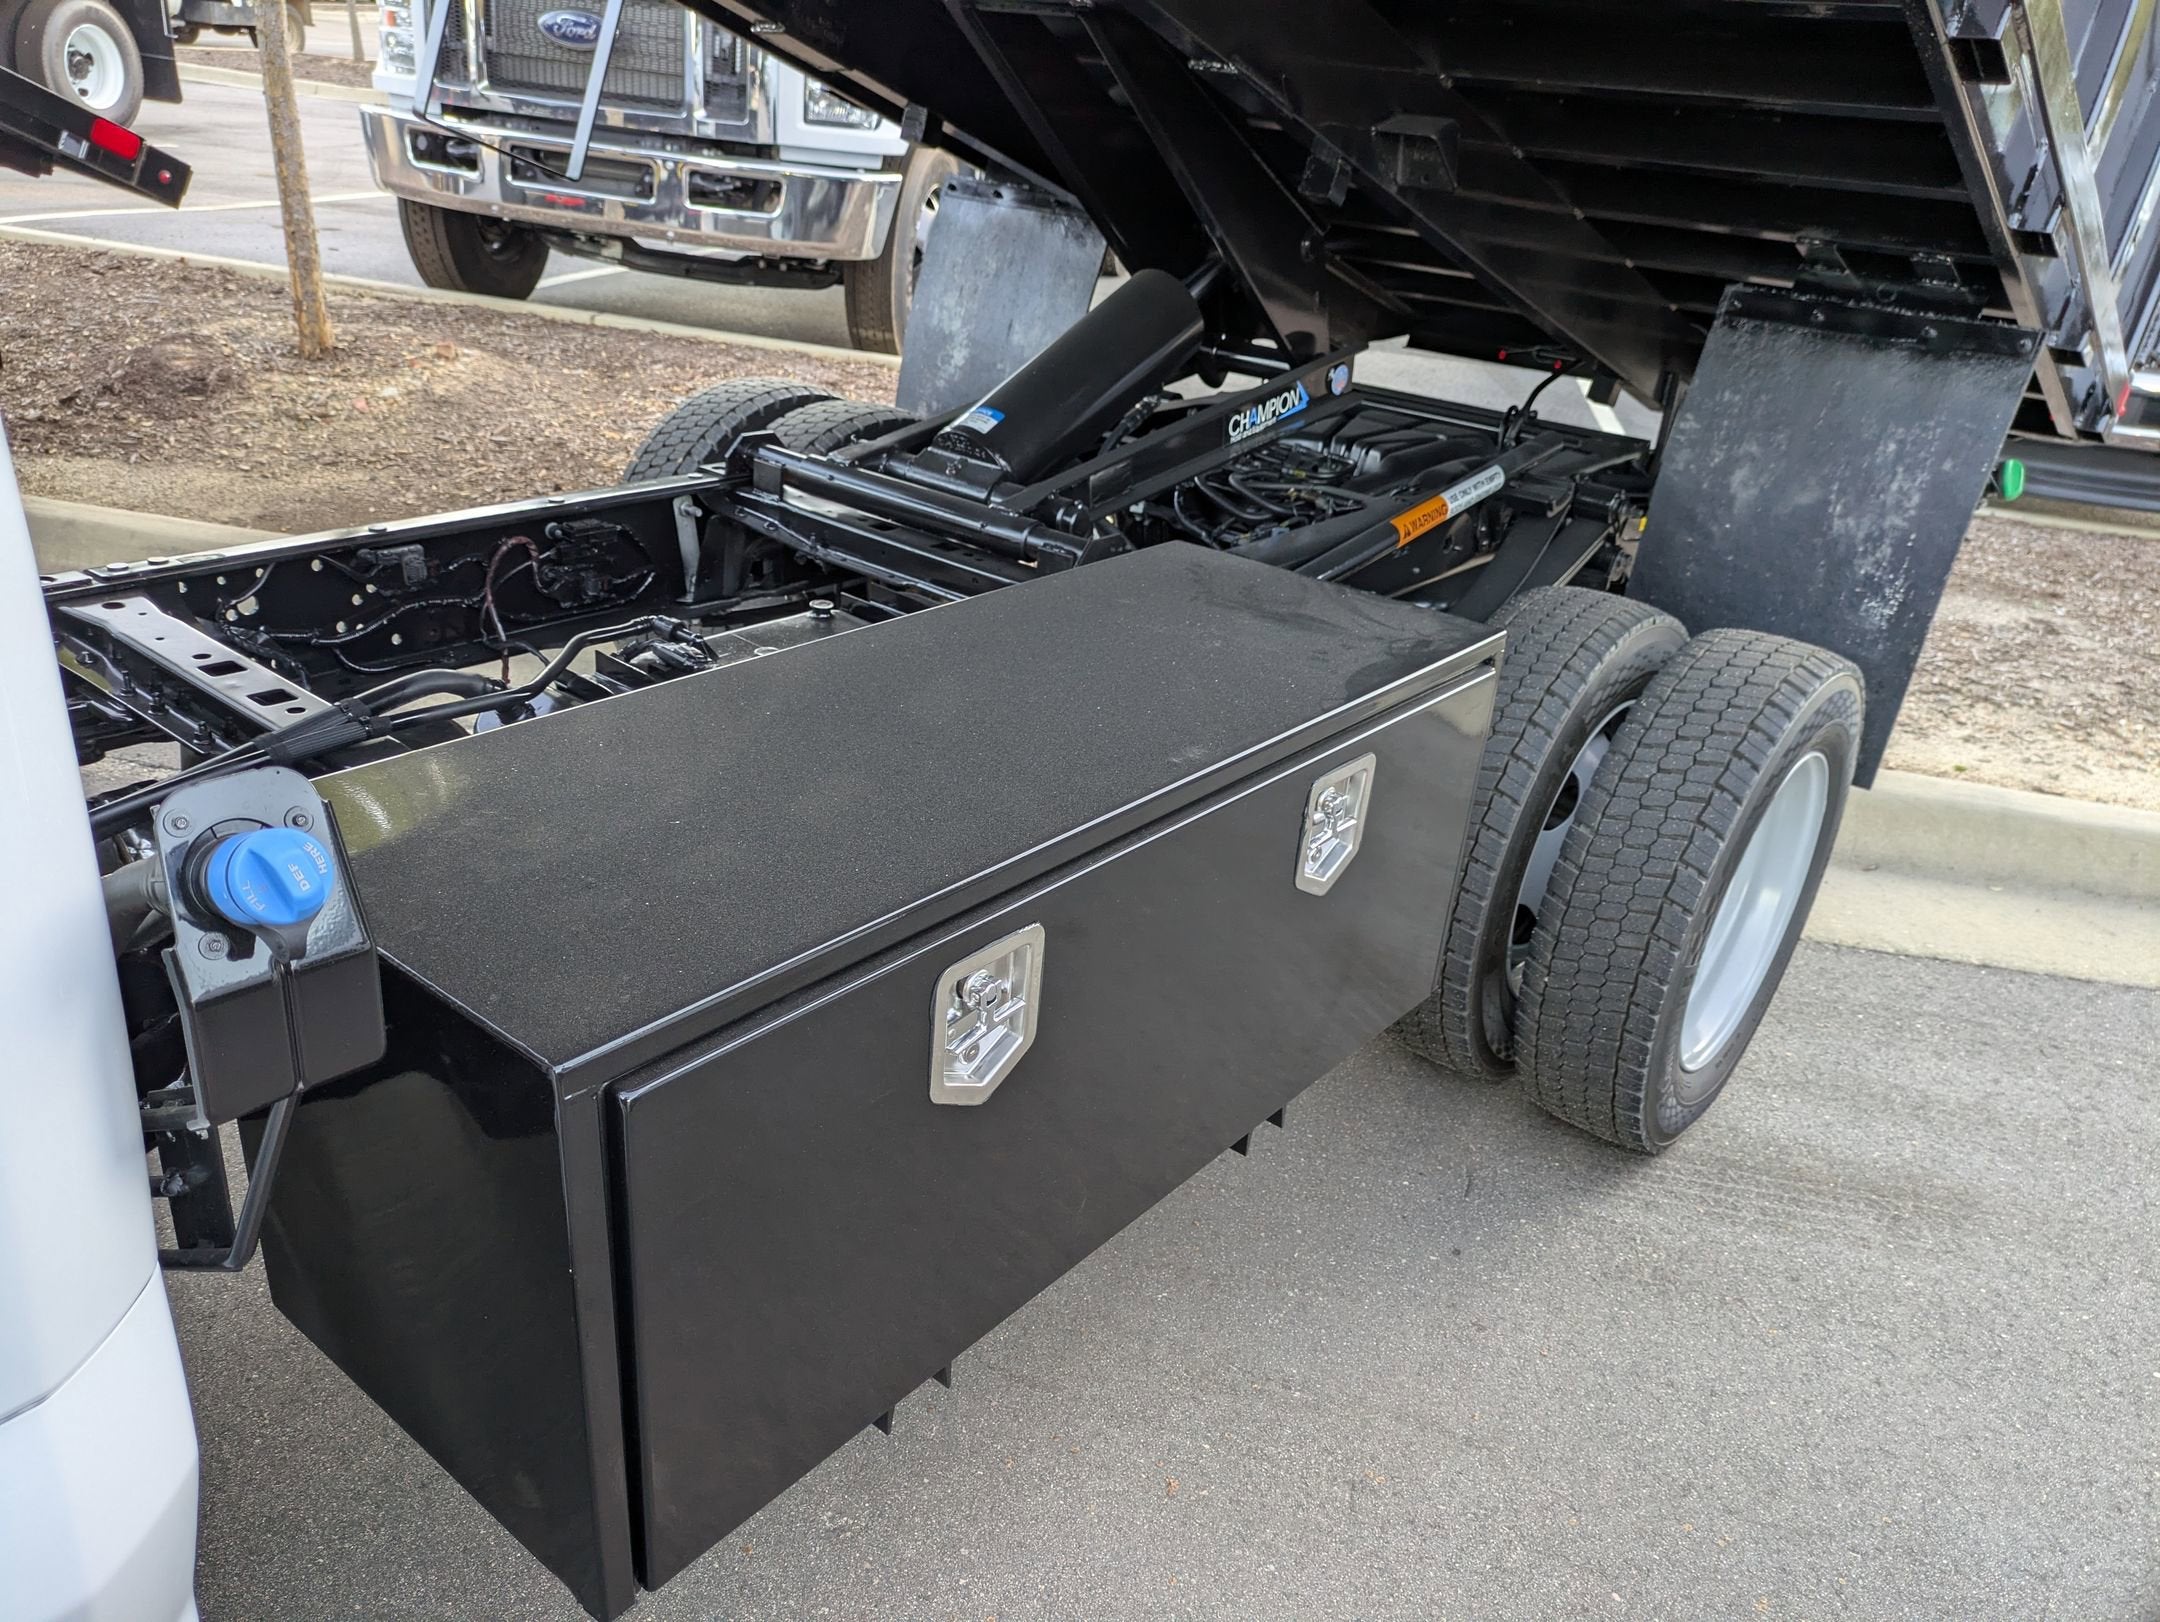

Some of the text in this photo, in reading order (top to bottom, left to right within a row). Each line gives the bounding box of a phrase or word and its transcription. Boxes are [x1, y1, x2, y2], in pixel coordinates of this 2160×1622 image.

[552, 14, 597, 39] Ford
[1228, 387, 1300, 437] CHAMPION
[1411, 503, 1448, 530] WARNING
[302, 841, 328, 875] HERE
[287, 863, 311, 892] DEF
[242, 880, 266, 912] FILL
